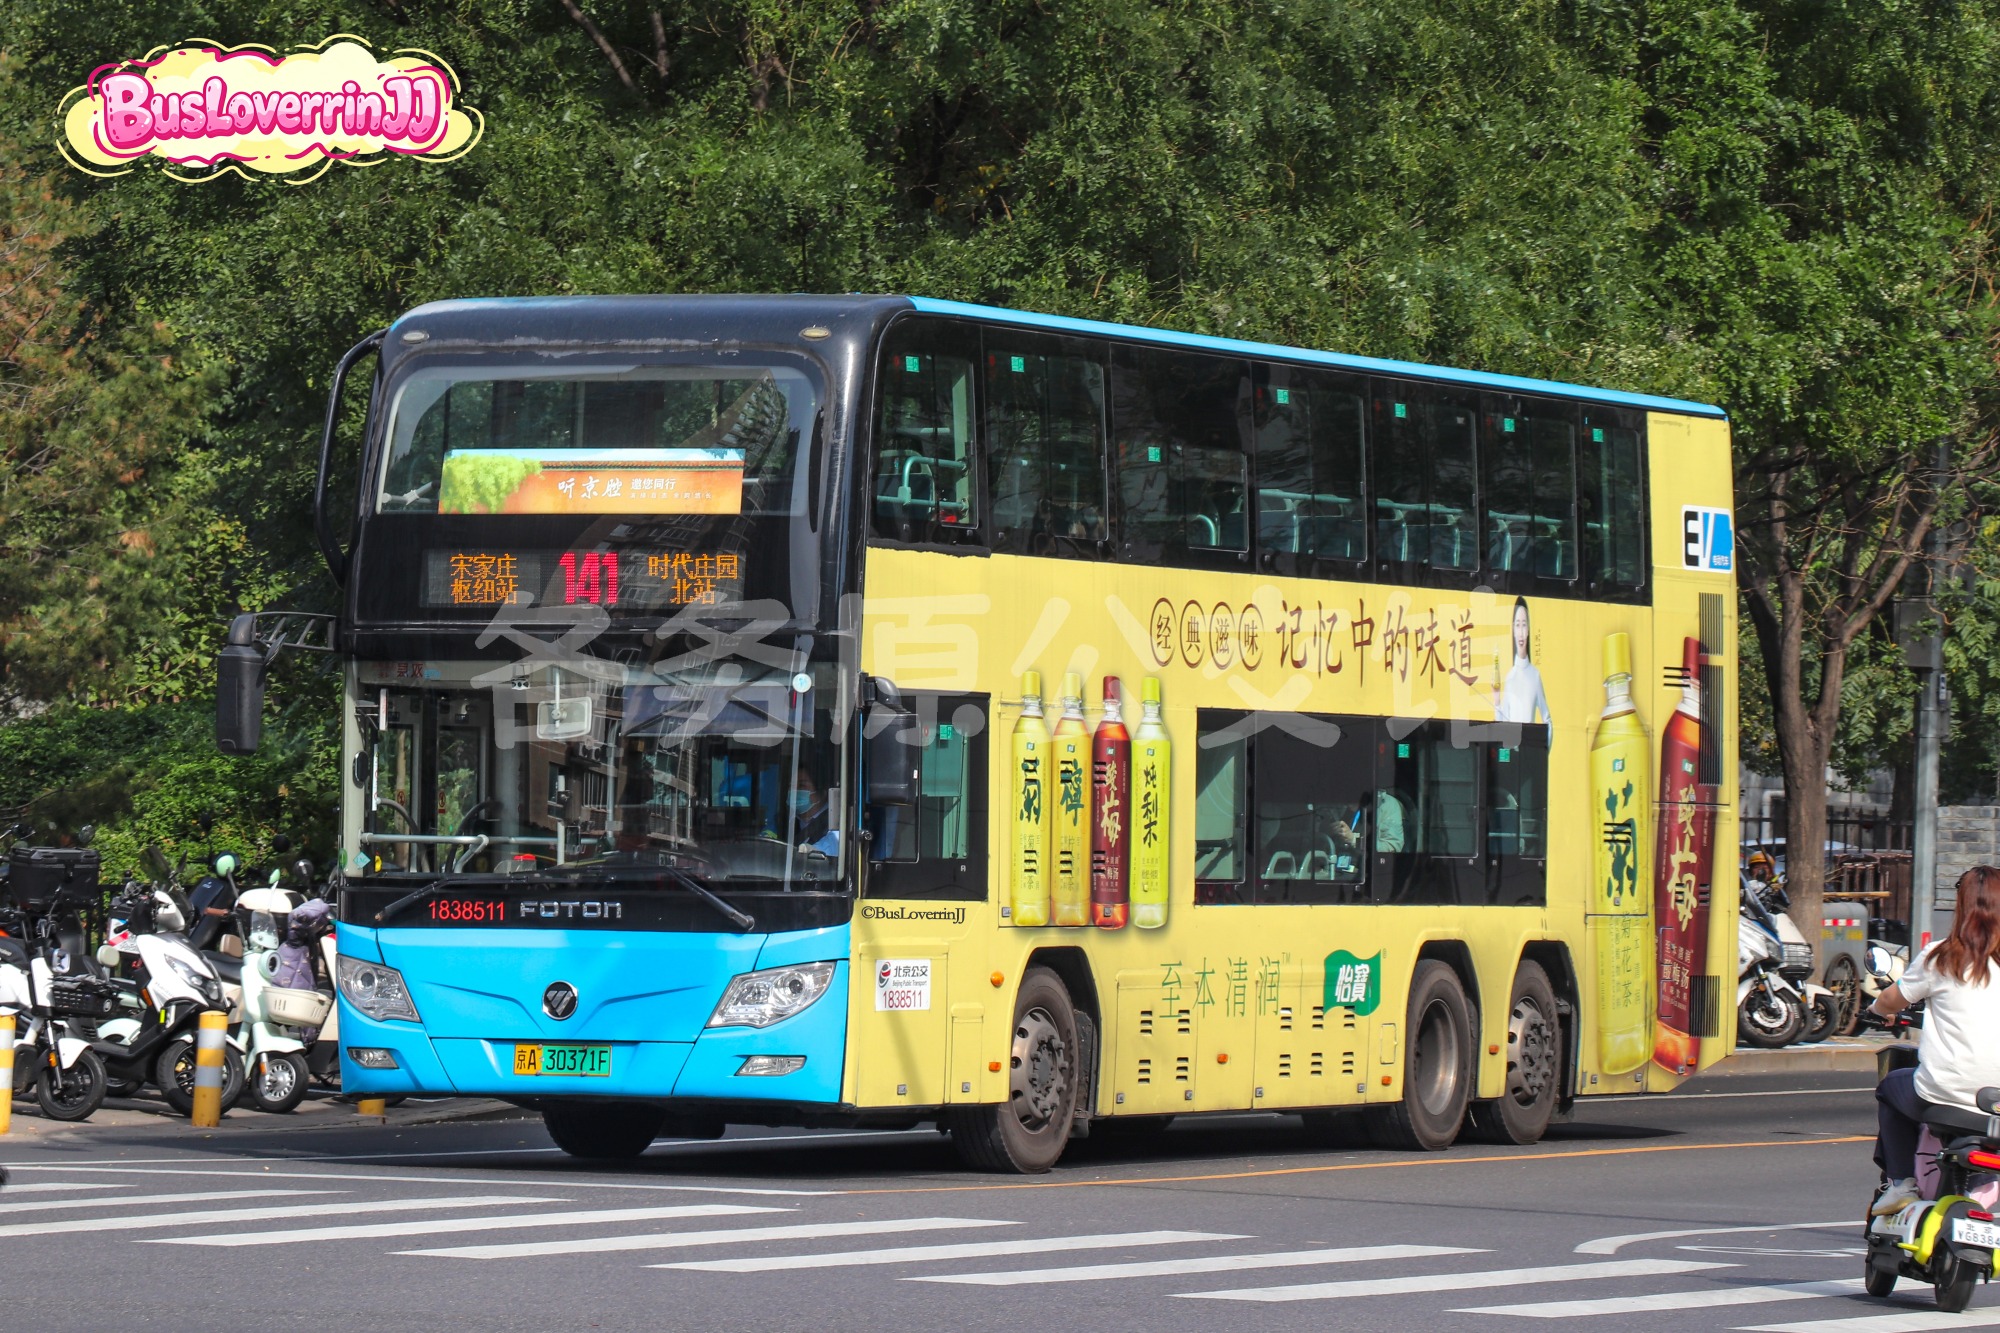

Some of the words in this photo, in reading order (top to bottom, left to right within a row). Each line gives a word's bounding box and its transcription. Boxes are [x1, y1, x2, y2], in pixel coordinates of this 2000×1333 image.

[631, 478, 676, 490] 邀您同行
[450, 553, 518, 580] 宋家庄
[560, 552, 618, 604] 141
[648, 553, 738, 580] 时代庄园
[451, 578, 518, 604] 枢纽站
[669, 578, 716, 604] 北站
[1154, 610, 1261, 660] 经典滋味
[1276, 598, 1479, 689] 记忆中的味道
[428, 900, 505, 921] 1838511
[520, 902, 622, 918] FOTON
[894, 965, 928, 978] 北京公交
[1335, 963, 1370, 1003] 怡寶
[883, 990, 922, 1008] 1838511
[1159, 955, 1281, 1019] 至本清润
